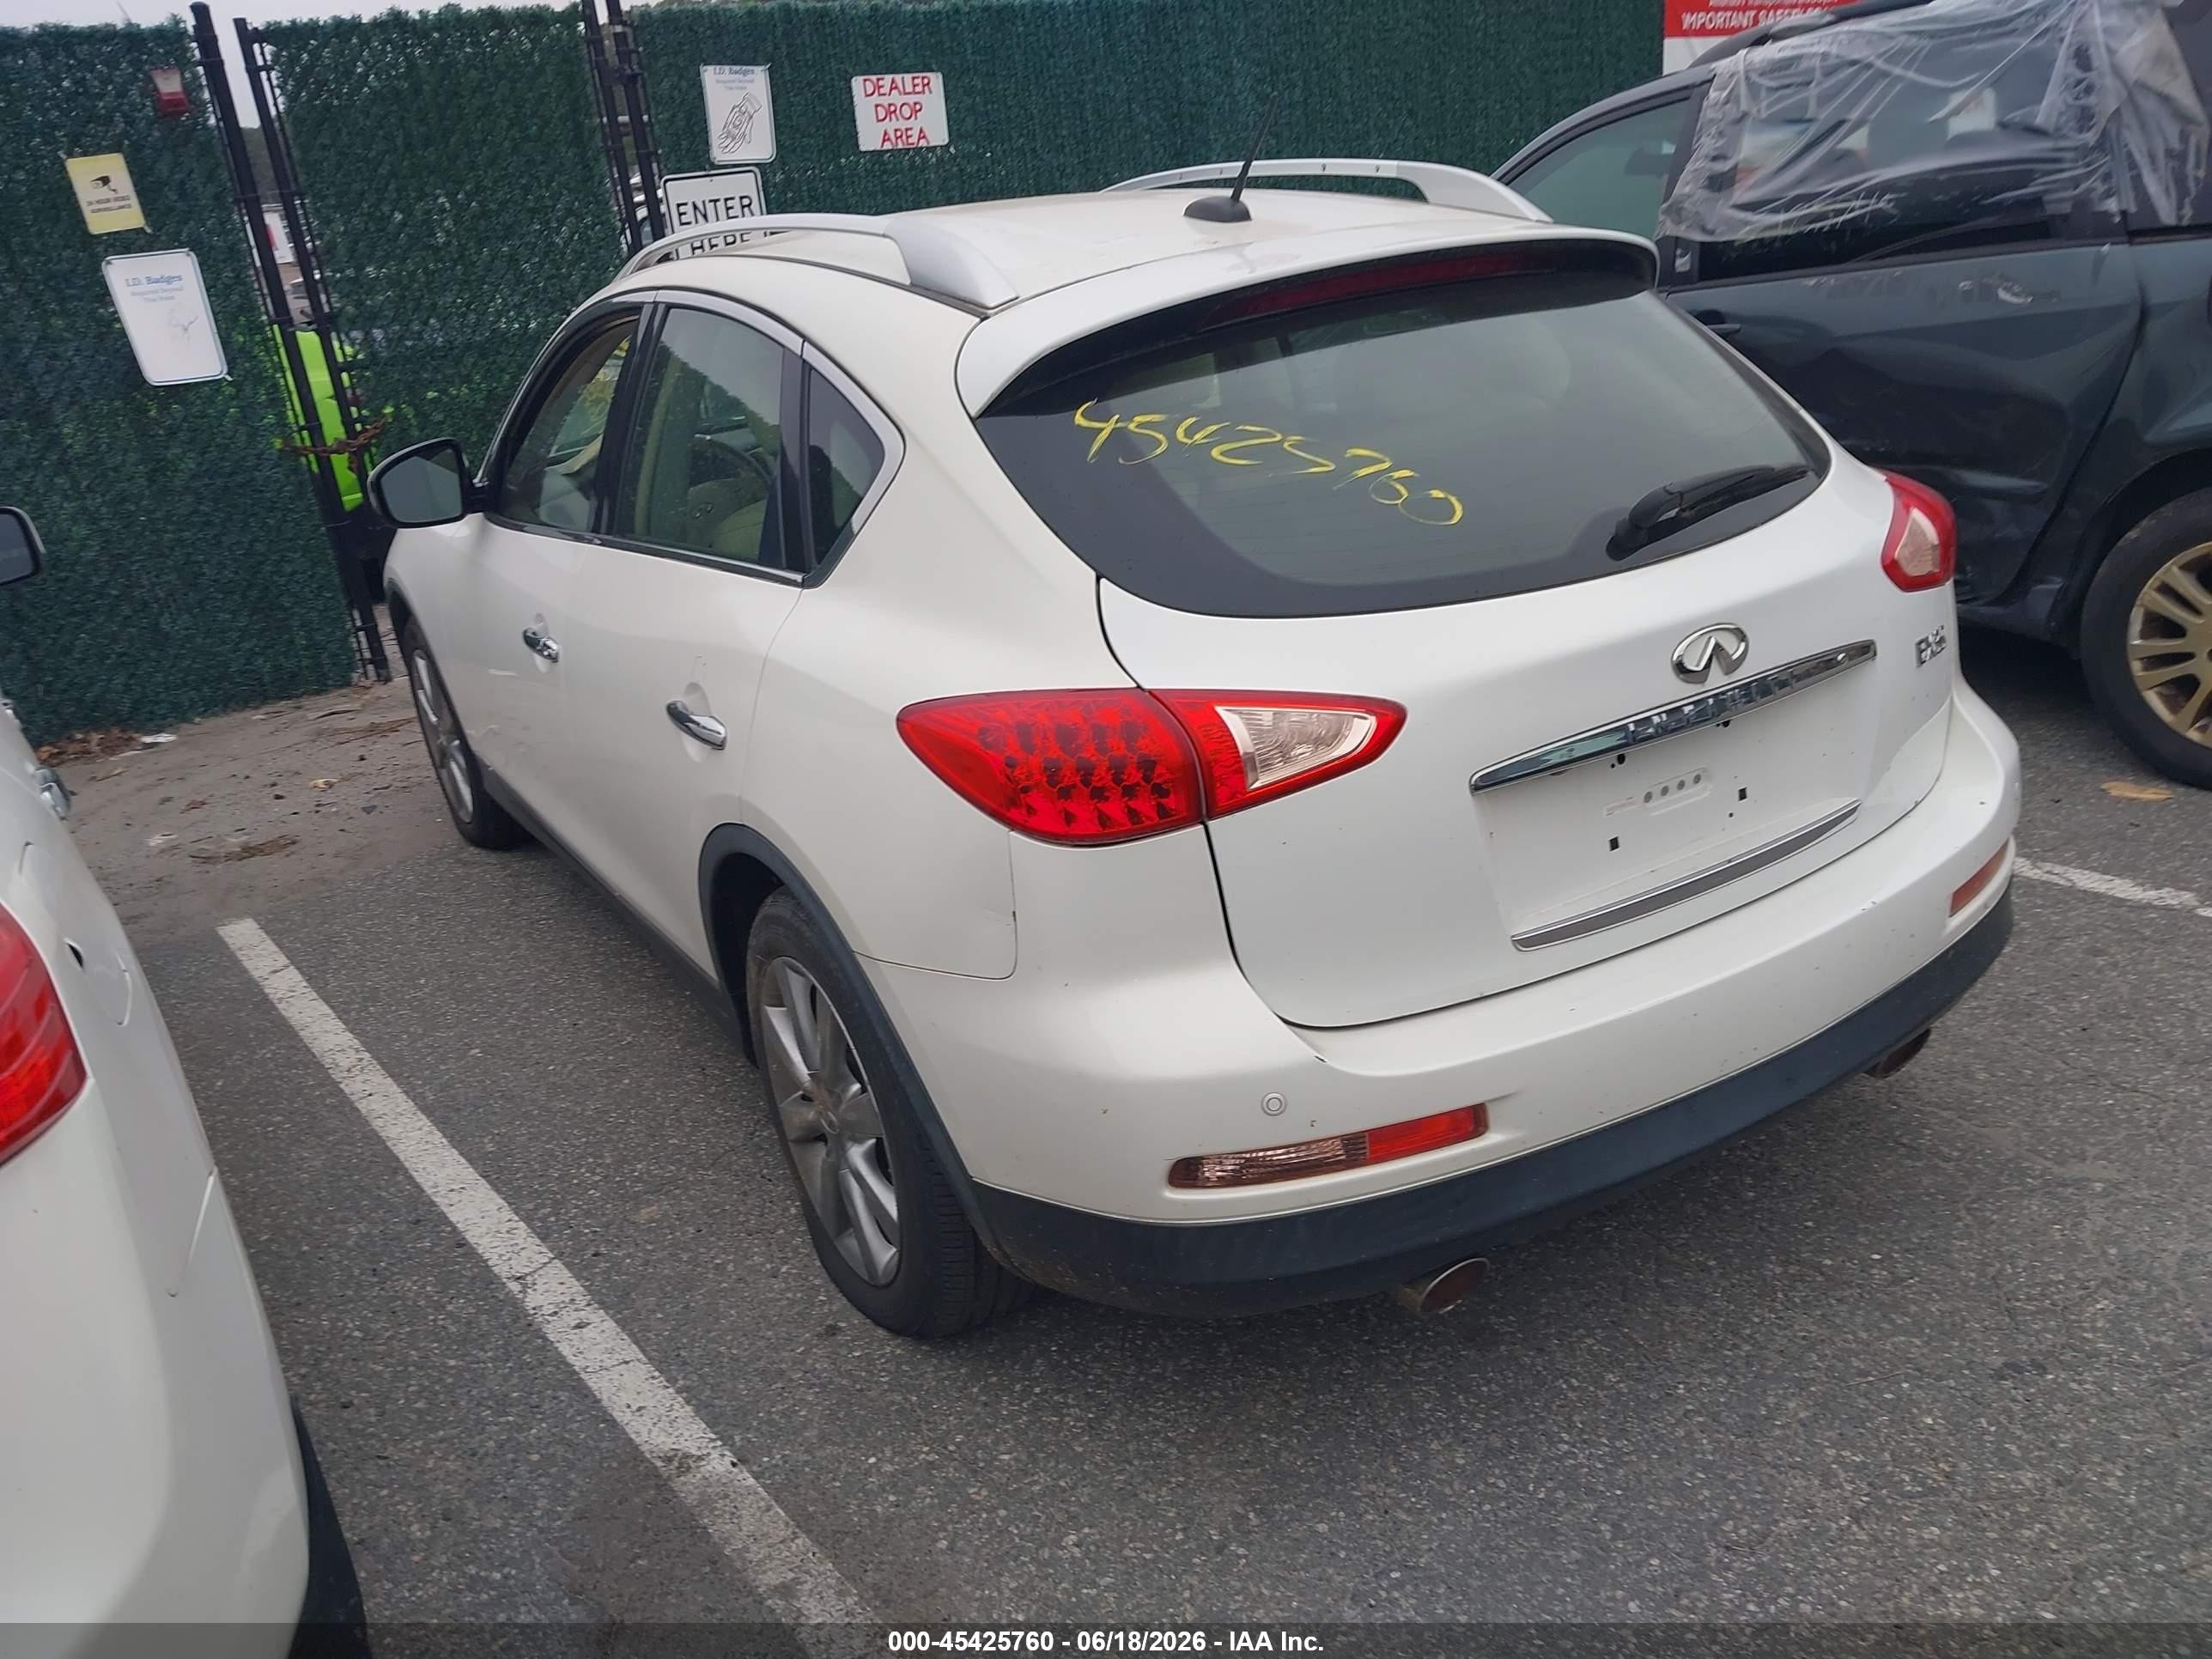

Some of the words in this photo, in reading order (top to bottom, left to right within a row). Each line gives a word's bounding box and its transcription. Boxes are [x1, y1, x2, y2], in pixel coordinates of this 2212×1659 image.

[1681, 10, 1758, 31] IMPORTANT
[862, 76, 933, 98] DEALER
[874, 100, 923, 123] DROP
[880, 126, 931, 149] AREA
[676, 195, 755, 227] ENTER
